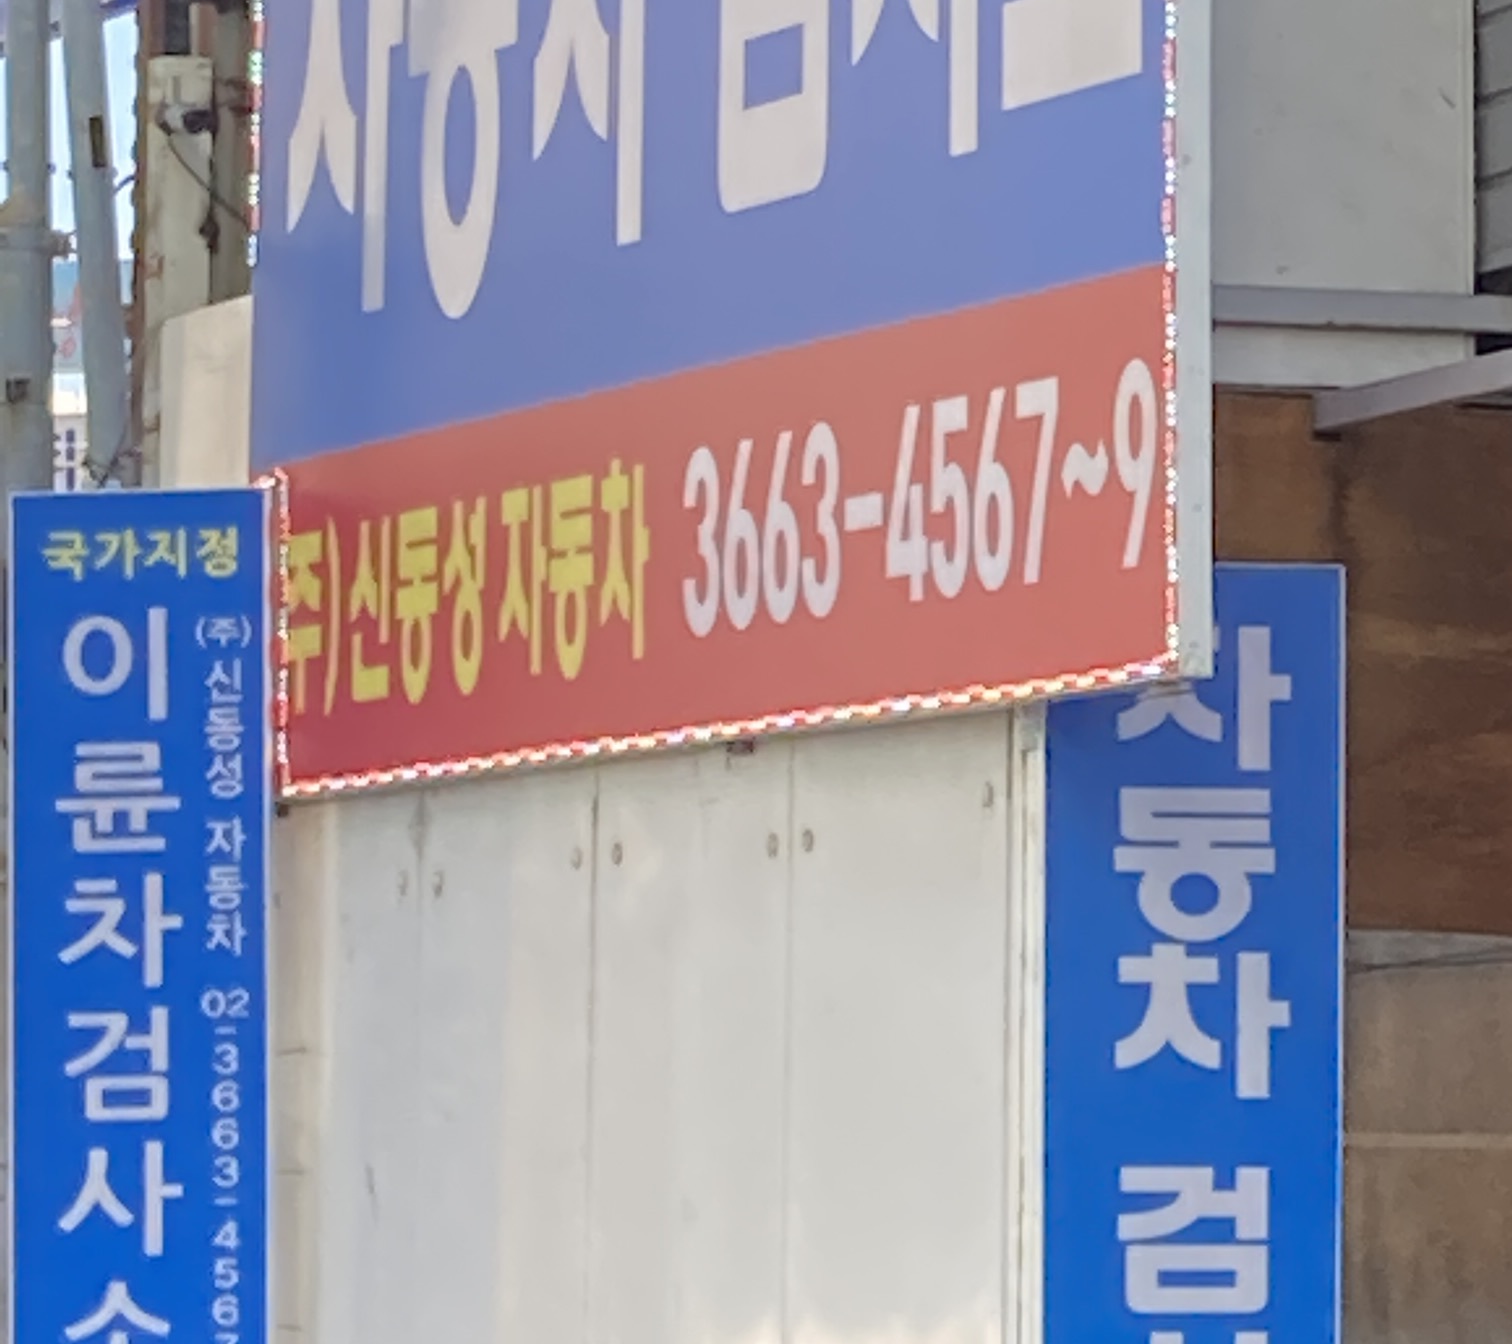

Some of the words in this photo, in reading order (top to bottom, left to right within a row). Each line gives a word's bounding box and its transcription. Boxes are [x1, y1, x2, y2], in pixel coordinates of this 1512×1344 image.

[42, 524, 239, 582] 국가지정
[498, 458, 650, 680] 자동차
[682, 357, 1158, 637] 3663-4567~9
[205, 817, 248, 957] 자동차
